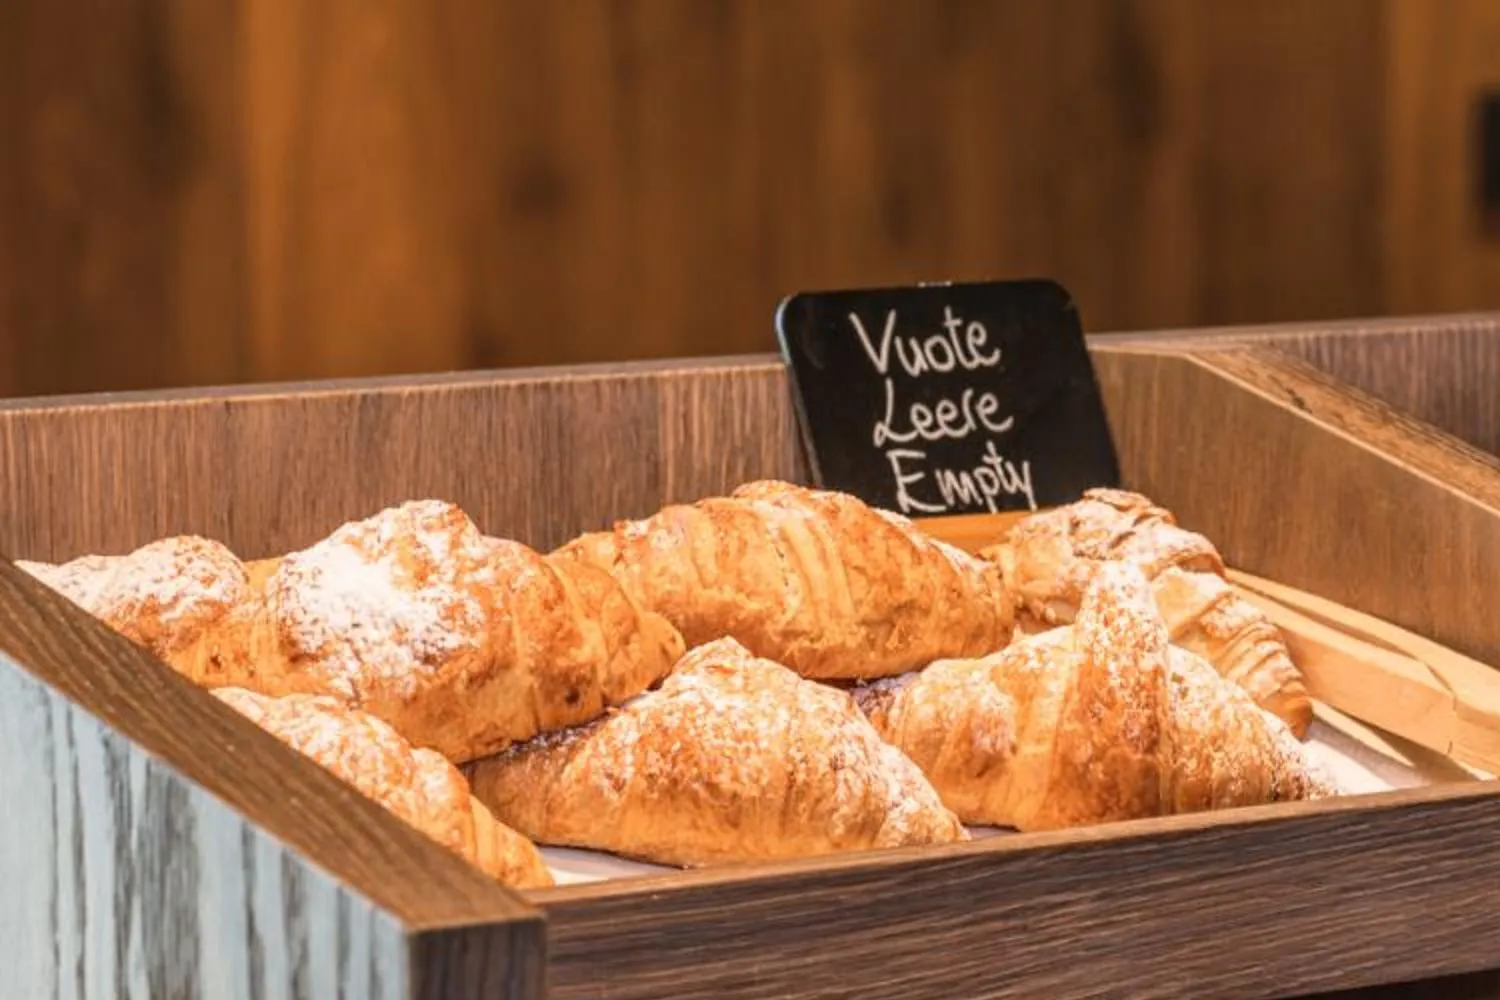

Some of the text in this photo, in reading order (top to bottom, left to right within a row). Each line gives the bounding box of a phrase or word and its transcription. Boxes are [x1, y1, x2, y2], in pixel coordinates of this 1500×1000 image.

[849, 306, 1001, 377] Vuote
[874, 378, 1014, 448] Leere
[887, 441, 1038, 513] Empty
